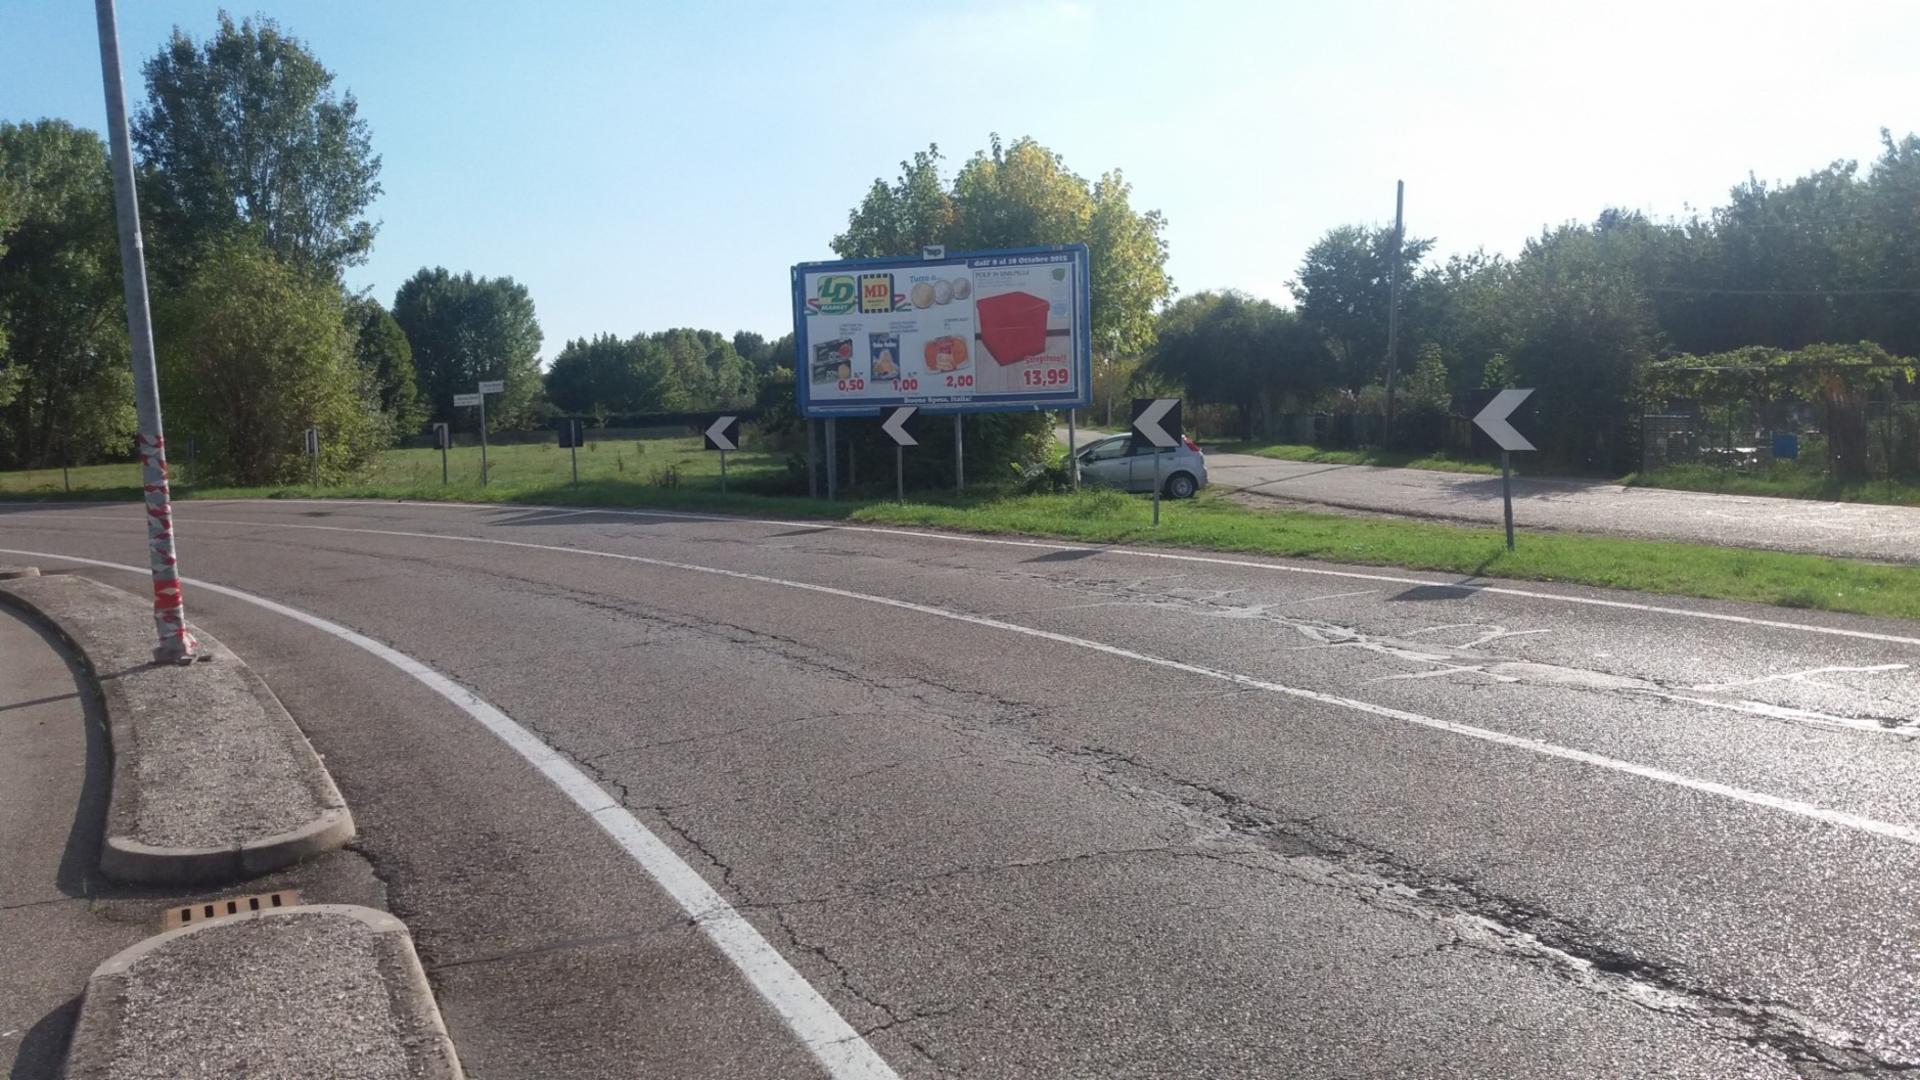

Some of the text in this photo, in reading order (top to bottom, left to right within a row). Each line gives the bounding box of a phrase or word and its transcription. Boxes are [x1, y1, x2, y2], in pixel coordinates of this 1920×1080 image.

[1019, 256, 1049, 264] Ottobre
[864, 284, 889, 298] MD
[946, 375, 974, 389] 2,00
[1023, 368, 1069, 387] 13,99
[838, 379, 864, 392] 0,50
[892, 379, 918, 392] 1,00
